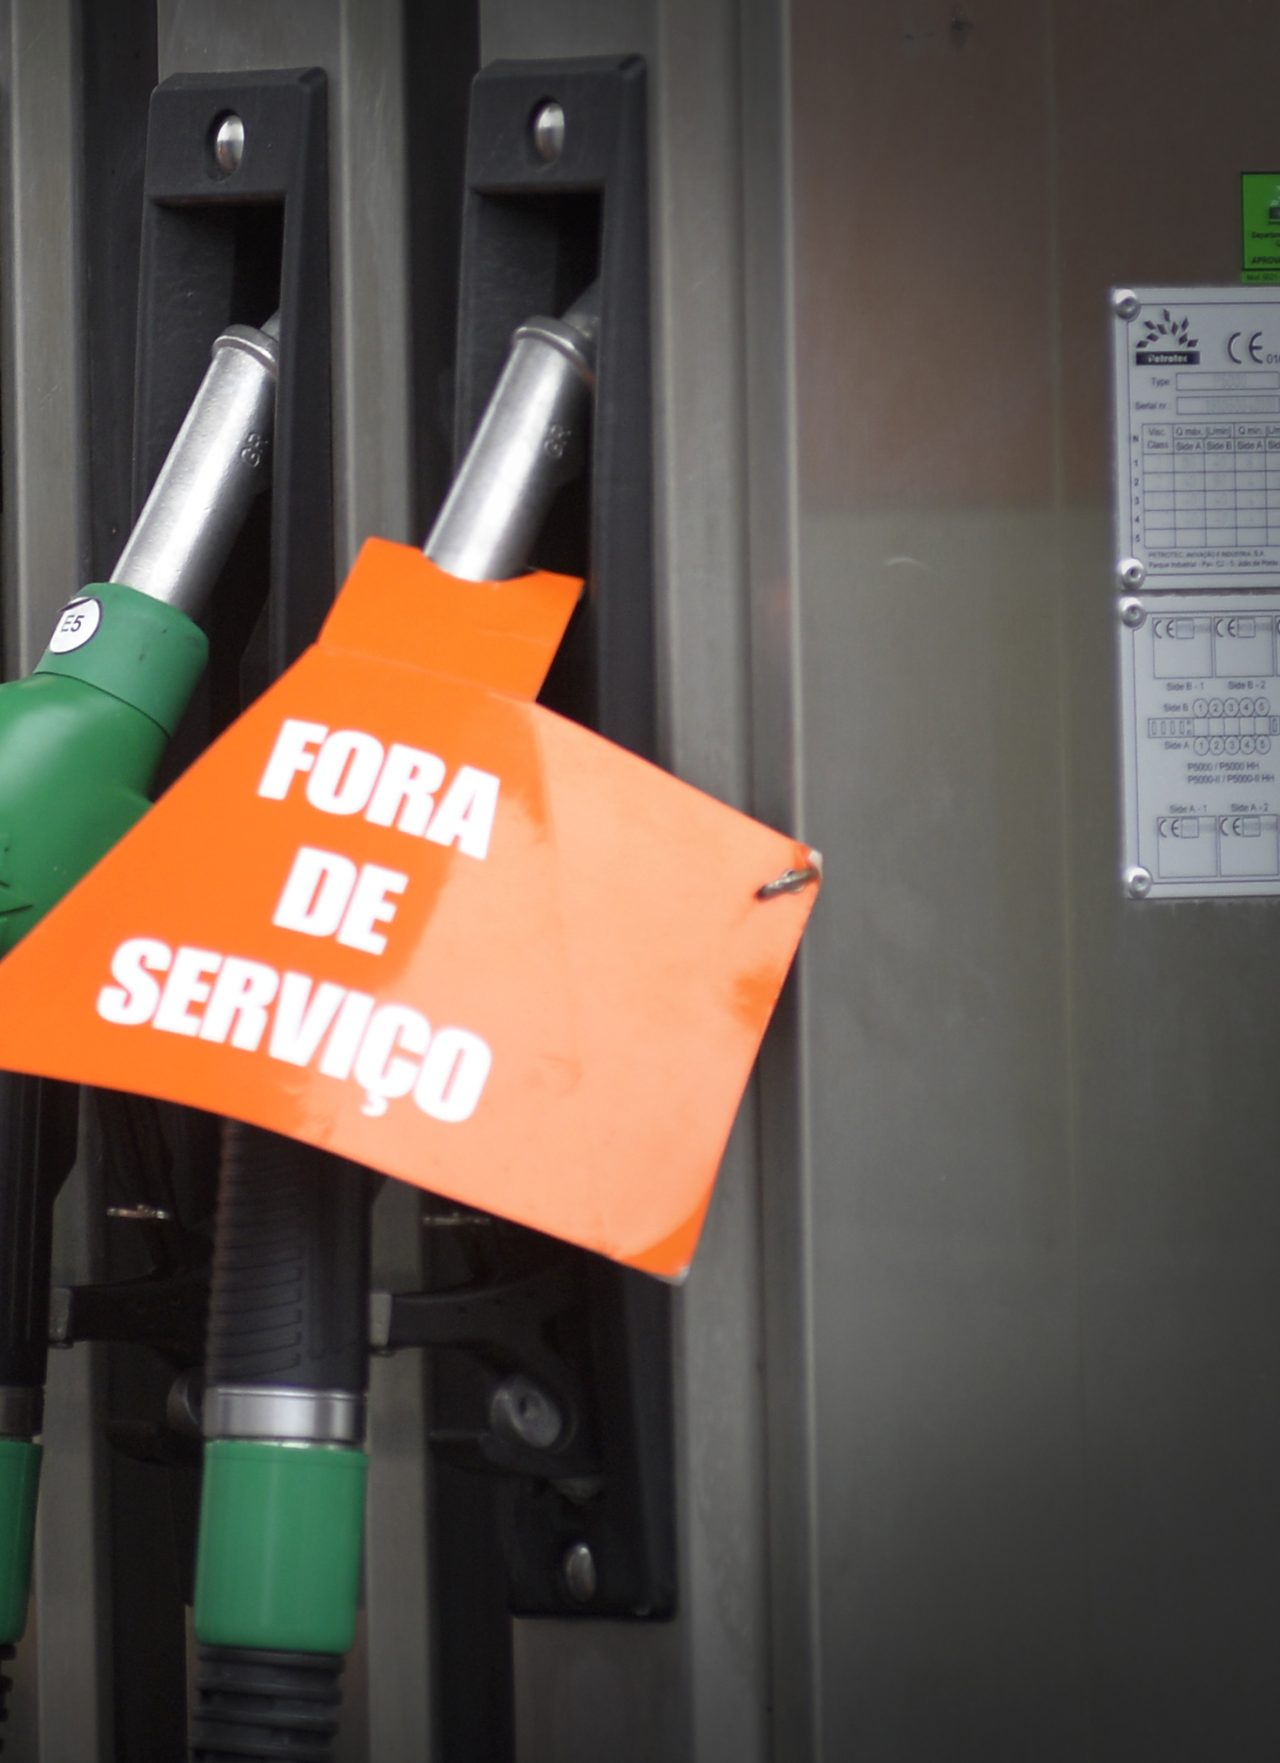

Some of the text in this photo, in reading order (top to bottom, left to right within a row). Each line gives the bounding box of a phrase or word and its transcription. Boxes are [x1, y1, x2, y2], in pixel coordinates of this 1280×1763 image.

[61, 615, 85, 632] E5
[257, 719, 501, 861] FORA
[272, 846, 409, 956] DE
[96, 938, 492, 1123] SERVIÇO
